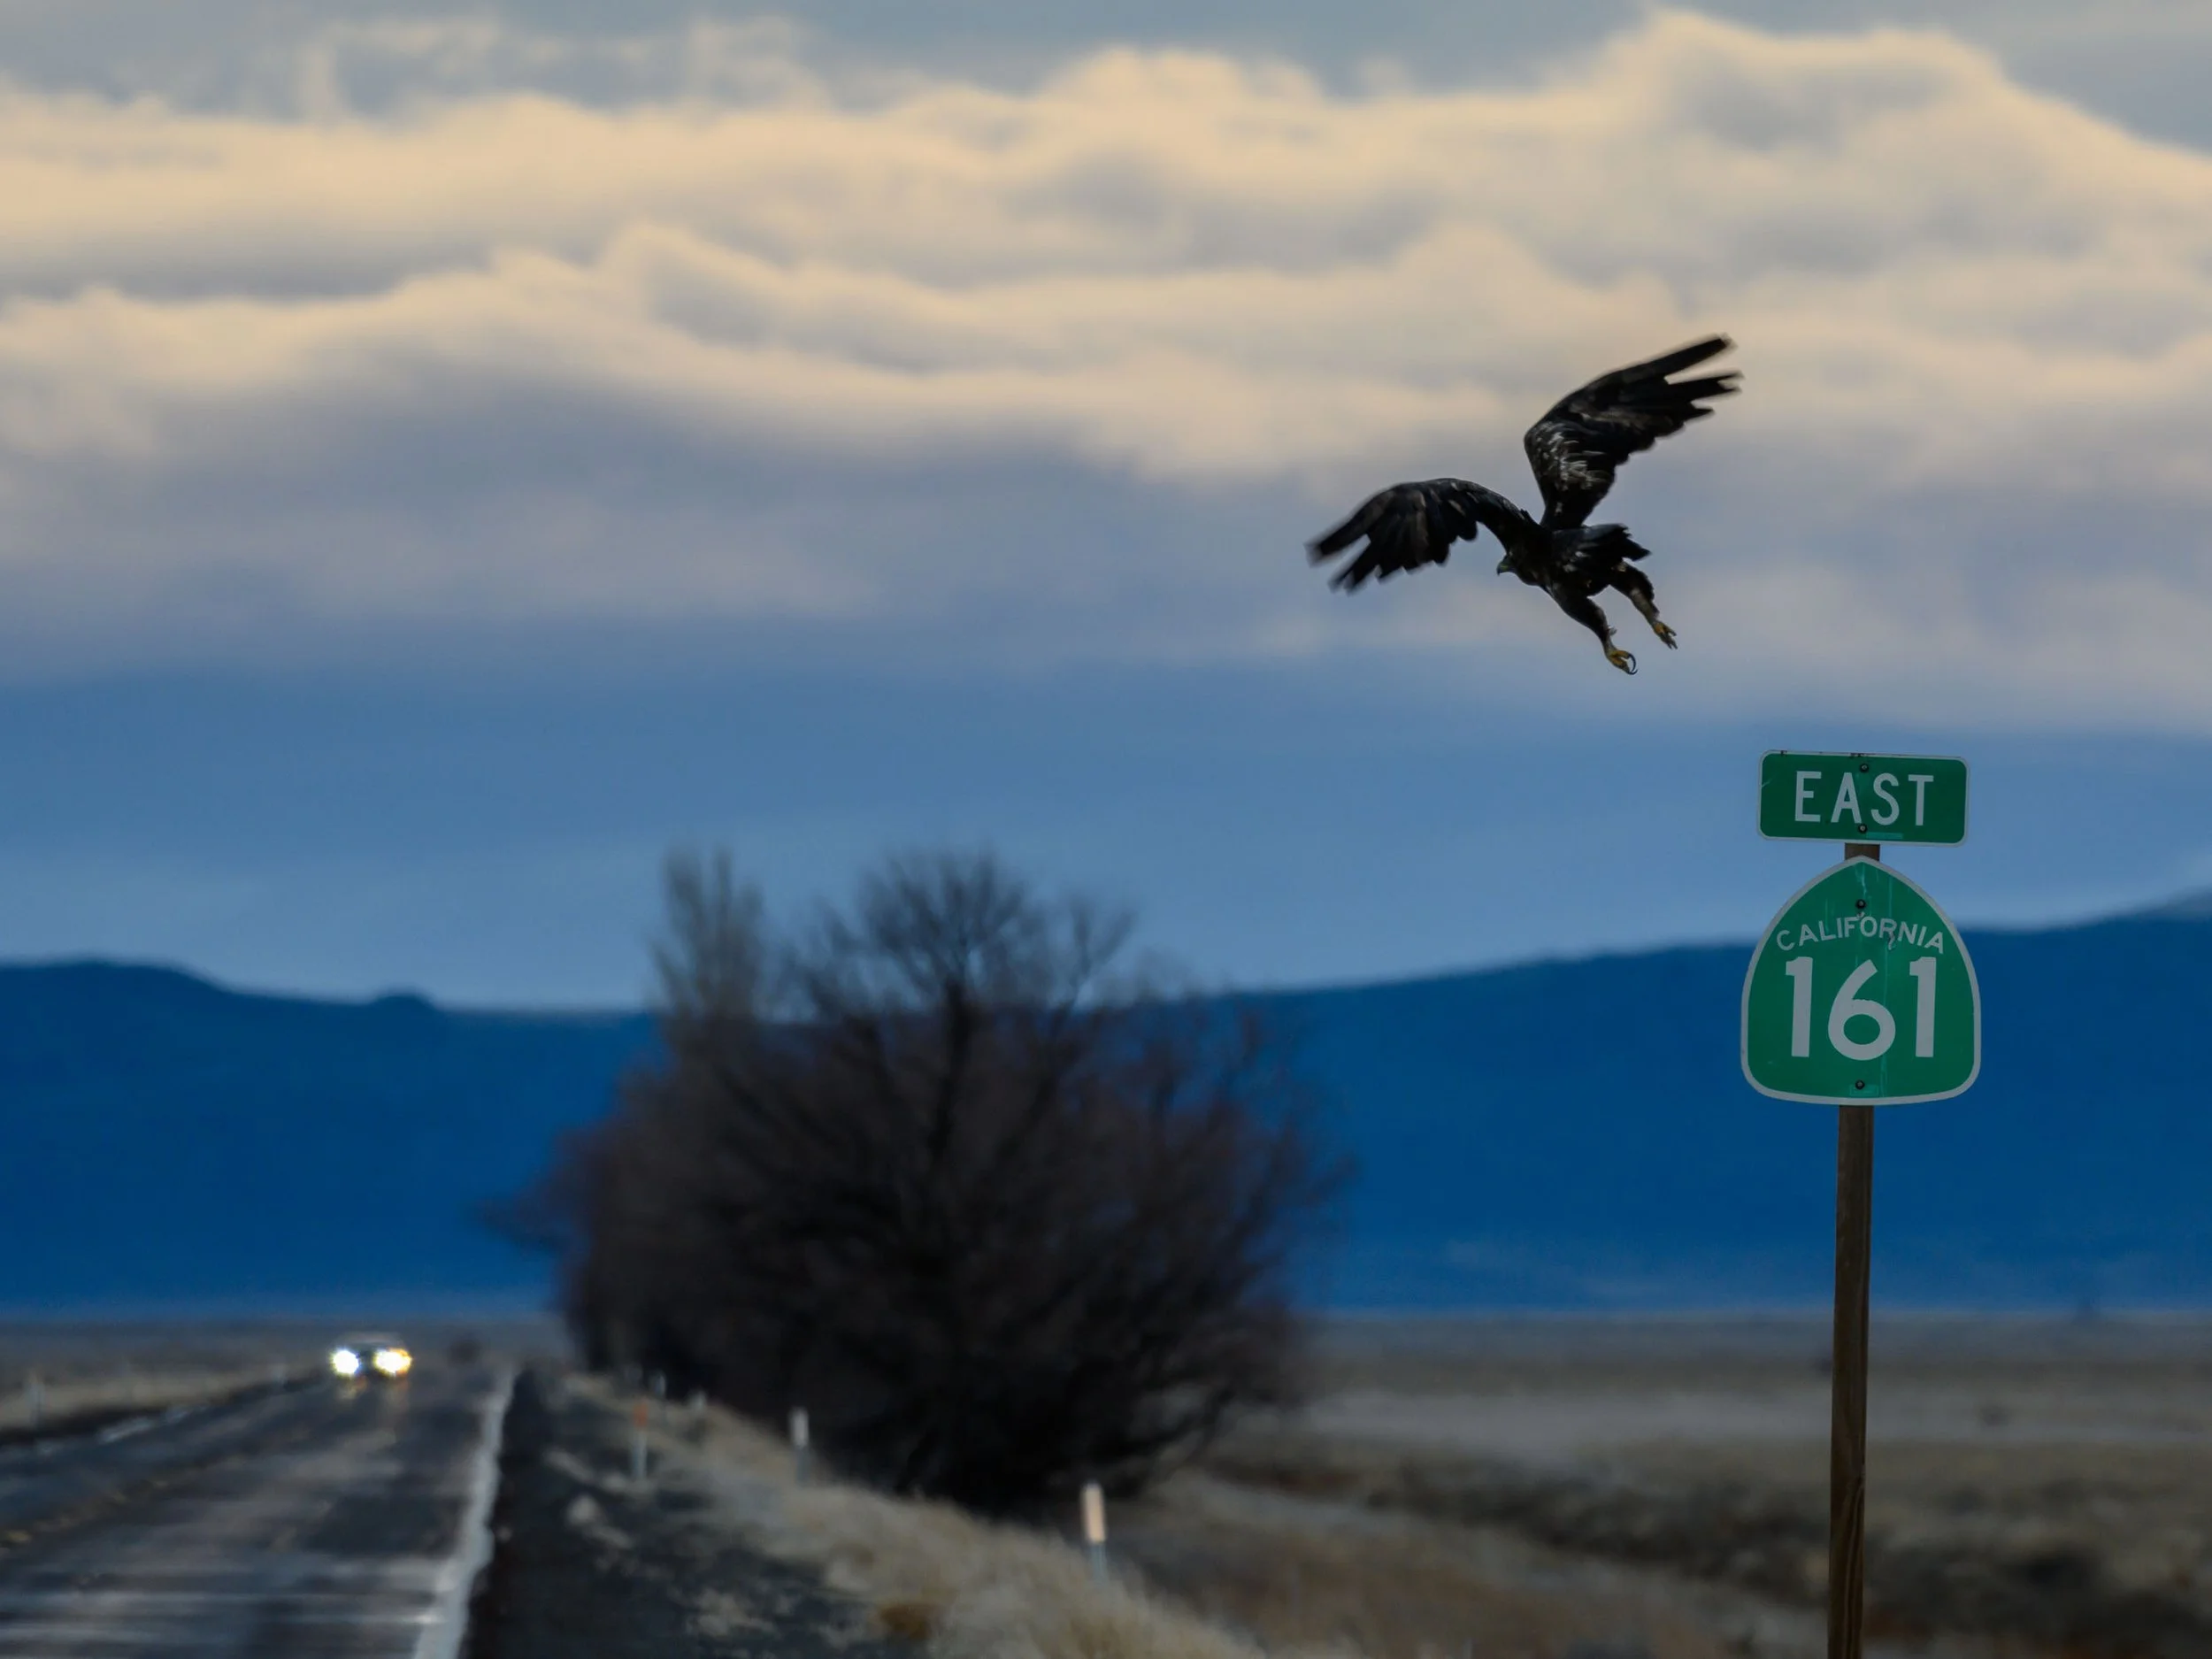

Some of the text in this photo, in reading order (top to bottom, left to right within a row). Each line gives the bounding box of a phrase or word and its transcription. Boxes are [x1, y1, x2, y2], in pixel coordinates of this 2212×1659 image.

[1794, 771, 1934, 826] EAST
[1776, 916, 1944, 954] CALIFORNIA
[1785, 956, 1936, 1061] 161
